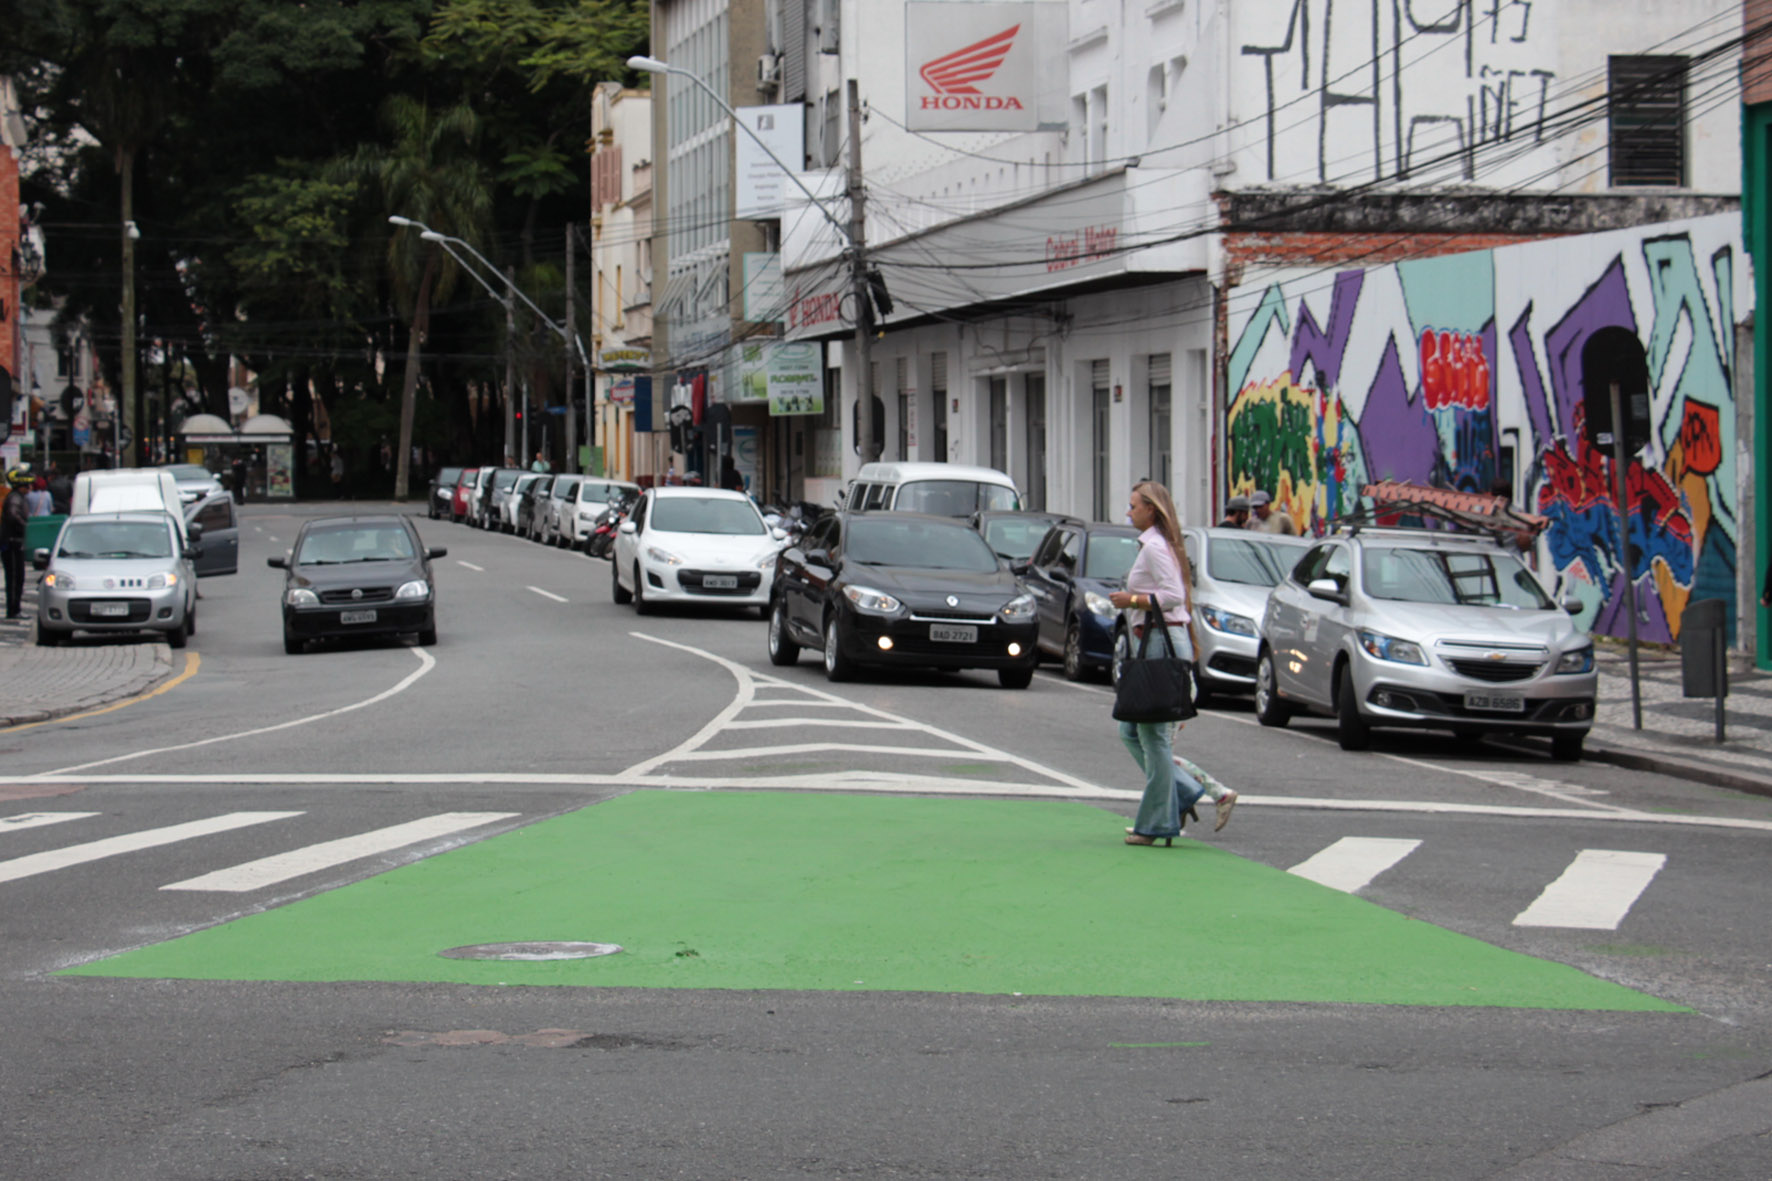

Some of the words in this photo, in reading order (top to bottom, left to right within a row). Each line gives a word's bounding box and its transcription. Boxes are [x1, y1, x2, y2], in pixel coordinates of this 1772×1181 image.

[920, 96, 1025, 110] HONDA
[1045, 230, 1080, 273] Cabral
[801, 291, 842, 327] HONDA
